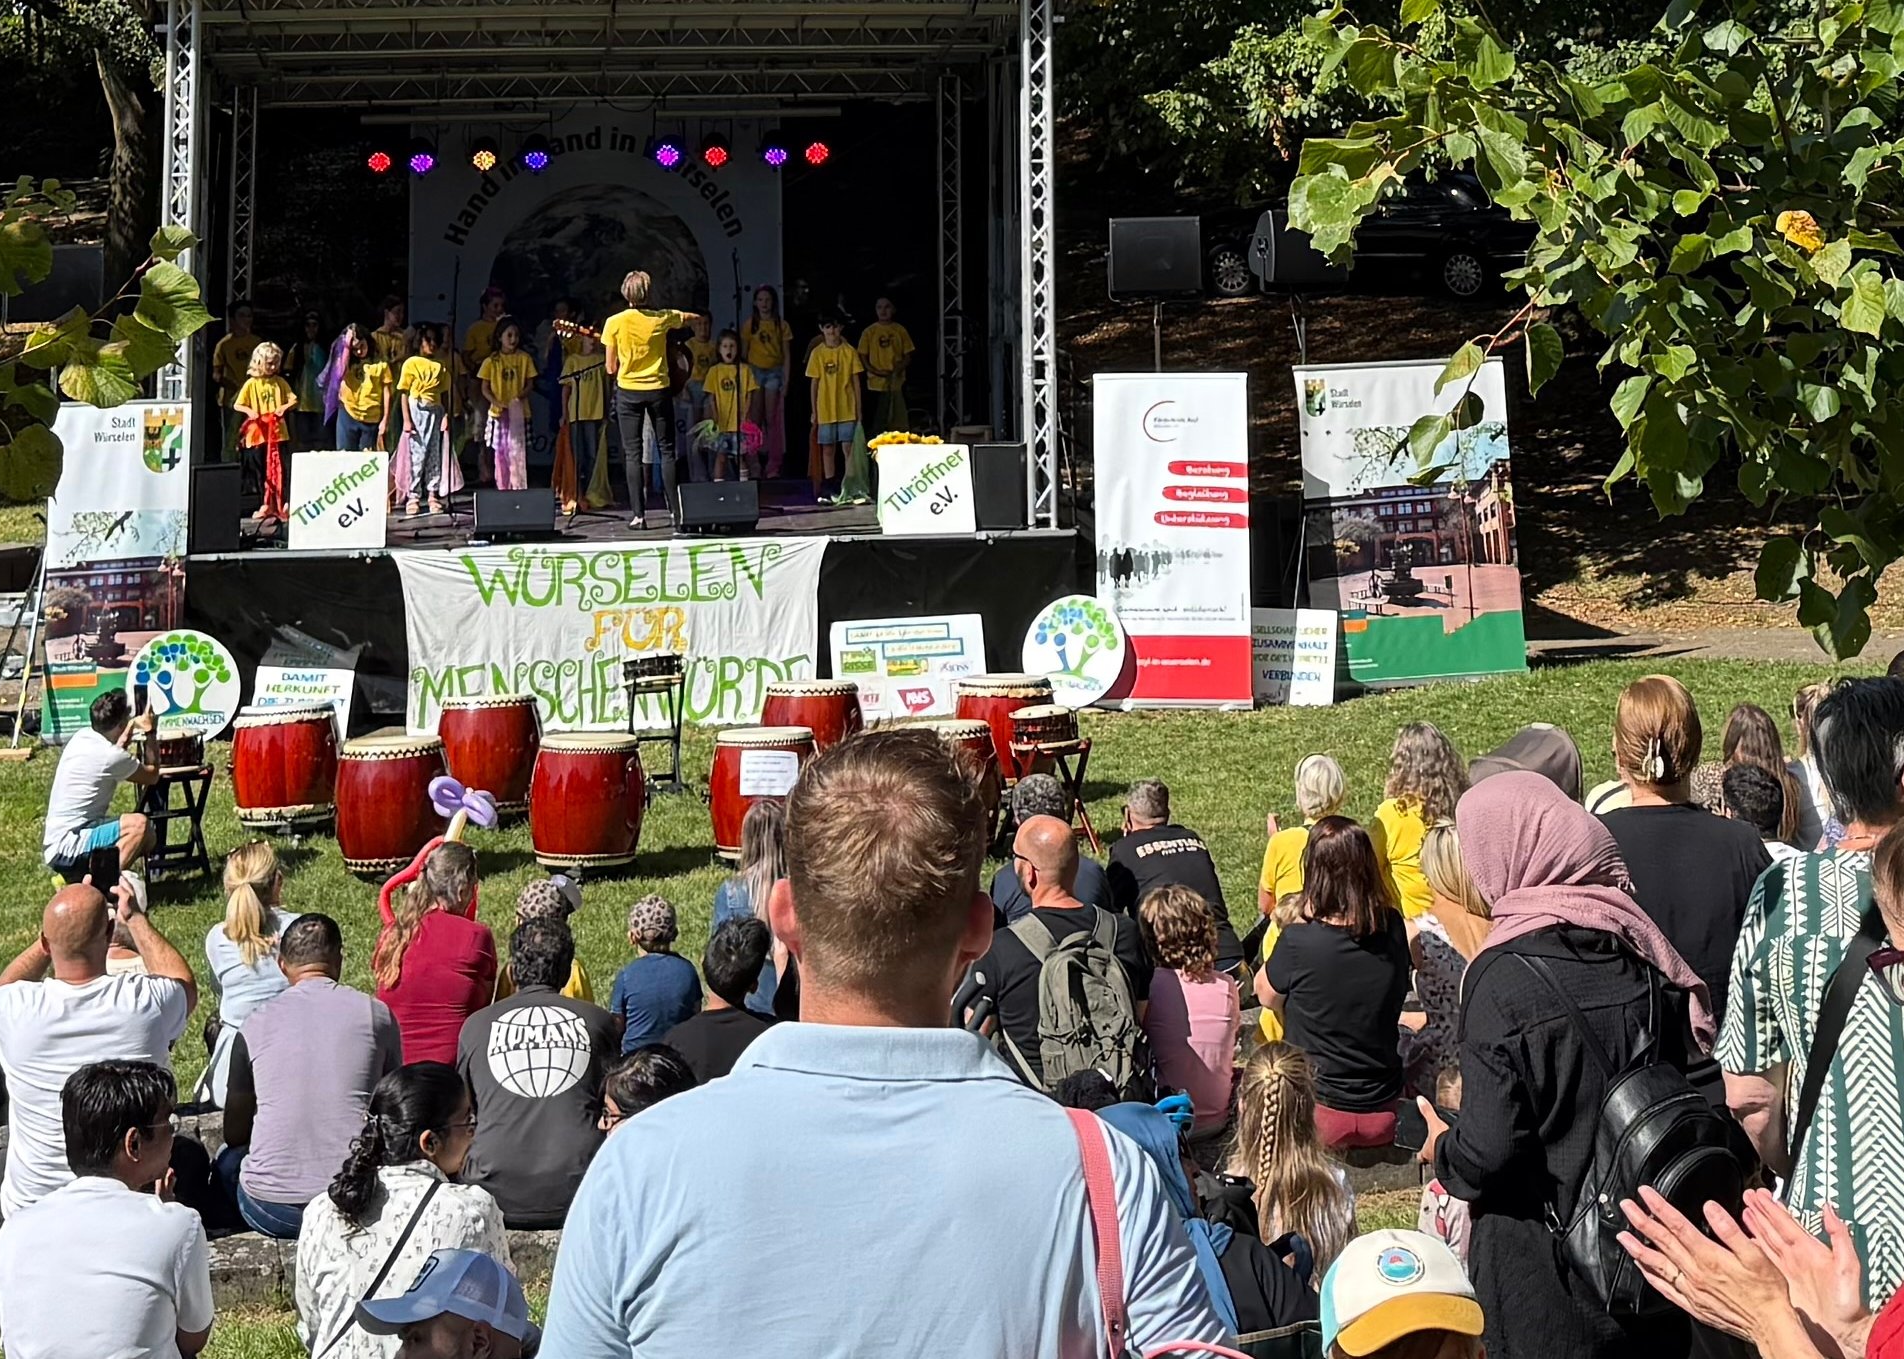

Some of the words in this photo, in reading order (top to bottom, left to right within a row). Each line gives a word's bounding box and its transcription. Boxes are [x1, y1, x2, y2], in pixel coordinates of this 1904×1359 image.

[444, 170, 500, 245] Hand
[550, 126, 601, 155] and
[611, 127, 635, 153] in
[111, 416, 135, 428] Stadt
[291, 457, 379, 525] Türöffner
[884, 449, 964, 512] Türöffner
[338, 497, 369, 528] e.V.
[930, 485, 958, 515] e.V.
[461, 544, 782, 611] WÜRSELEN
[584, 607, 688, 652] FÜR
[266, 684, 341, 694] HERKUNFT
[282, 673, 327, 682] DAMIT
[489, 1018, 591, 1056] HUMANS
